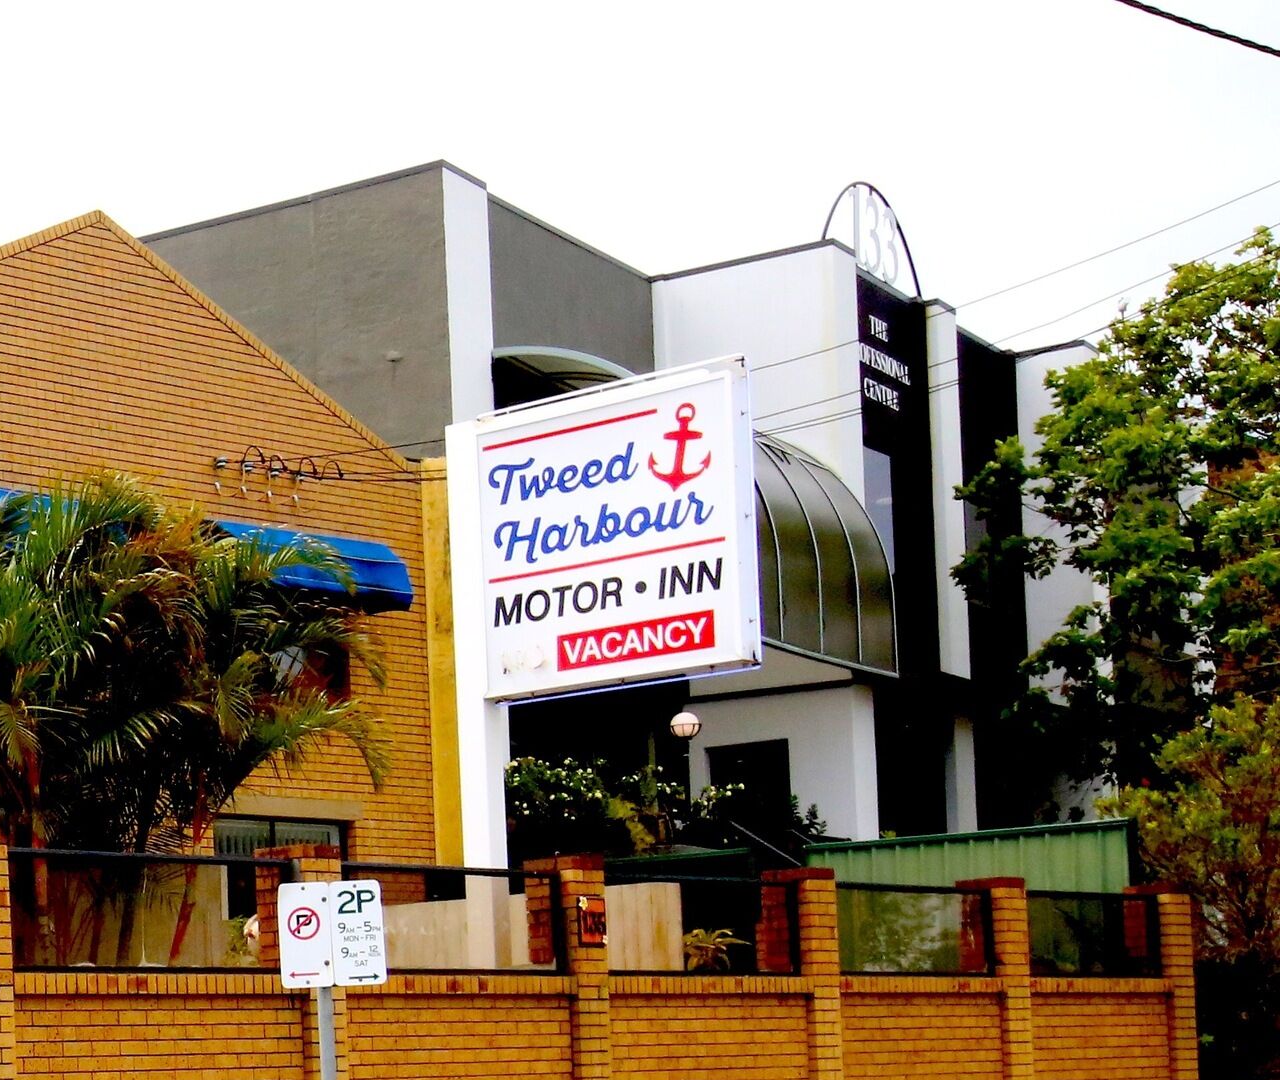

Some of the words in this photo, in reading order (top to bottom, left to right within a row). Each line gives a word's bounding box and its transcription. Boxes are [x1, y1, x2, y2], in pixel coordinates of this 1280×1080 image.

[869, 315, 888, 342] THE
[860, 342, 911, 386] OFESSIONAL
[864, 377, 900, 412] CENTRE
[488, 441, 639, 505] Tweed
[493, 491, 714, 564] Harbour
[493, 577, 623, 628] MOTOR
[658, 557, 723, 600] INN
[563, 617, 708, 665] VACANCY
[337, 889, 376, 914] 2P
